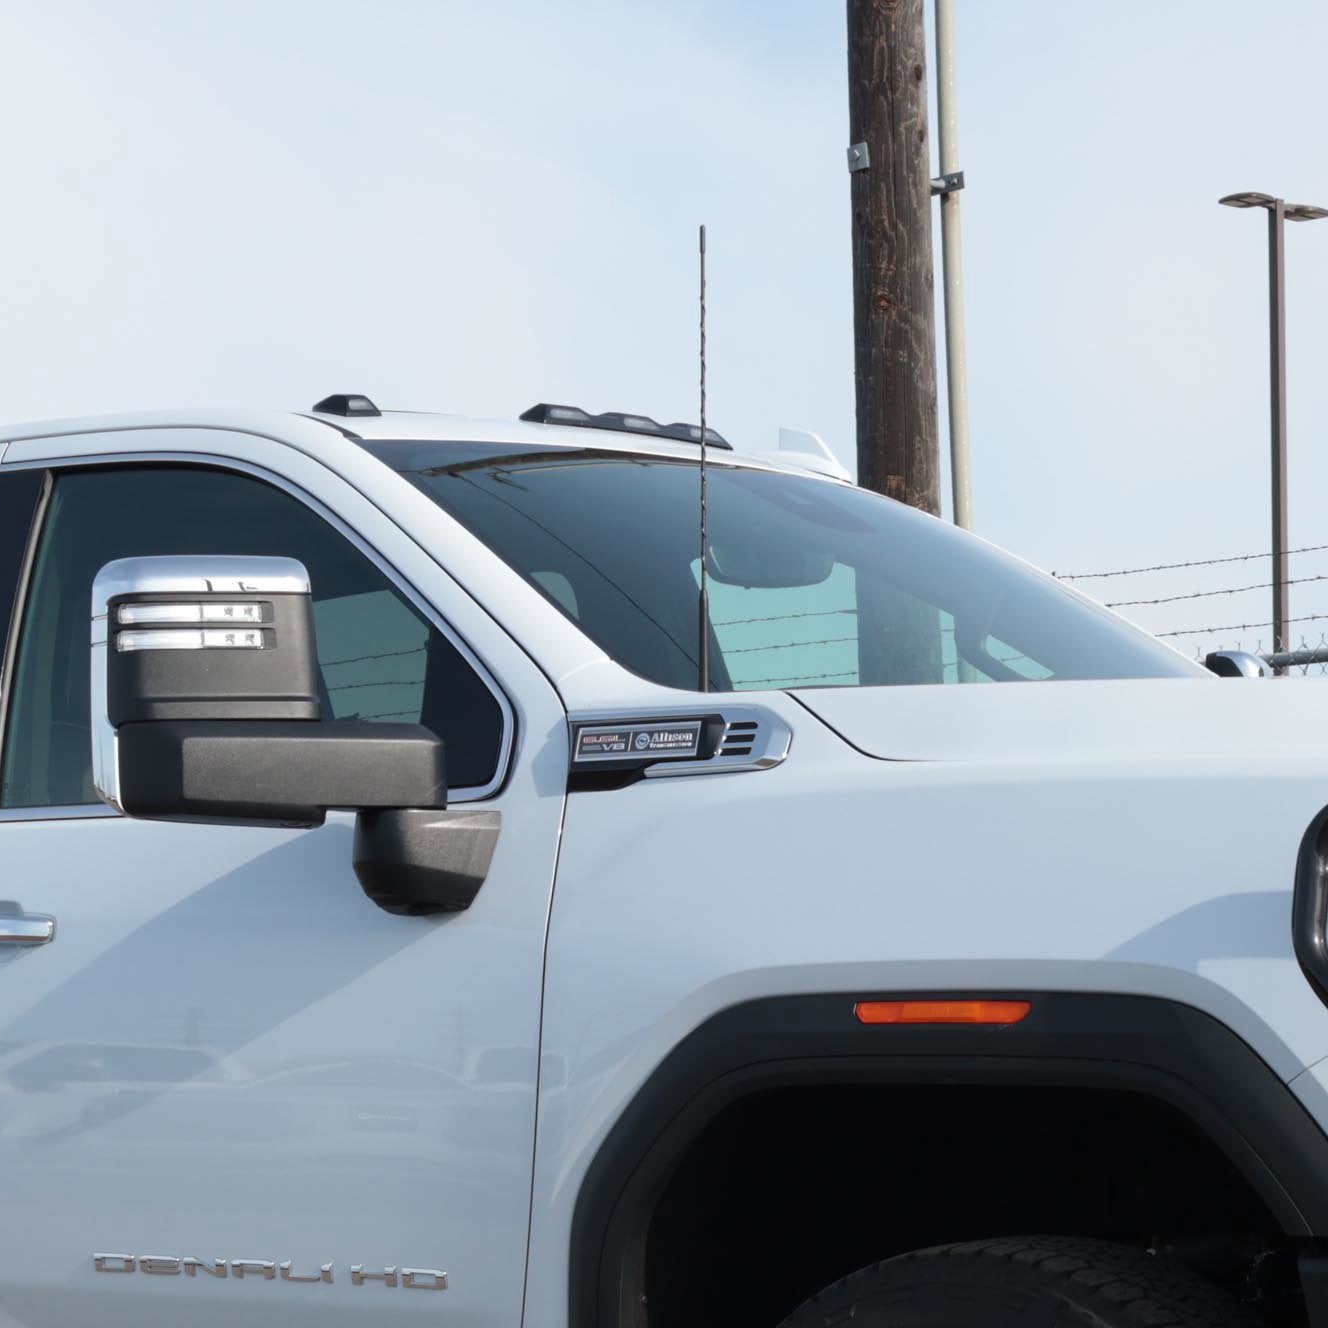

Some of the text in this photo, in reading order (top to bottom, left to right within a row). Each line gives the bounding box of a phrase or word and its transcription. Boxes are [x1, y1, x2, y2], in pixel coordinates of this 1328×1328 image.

[651, 731, 693, 743] Allison
[92, 1251, 449, 1291] DENALI HD
